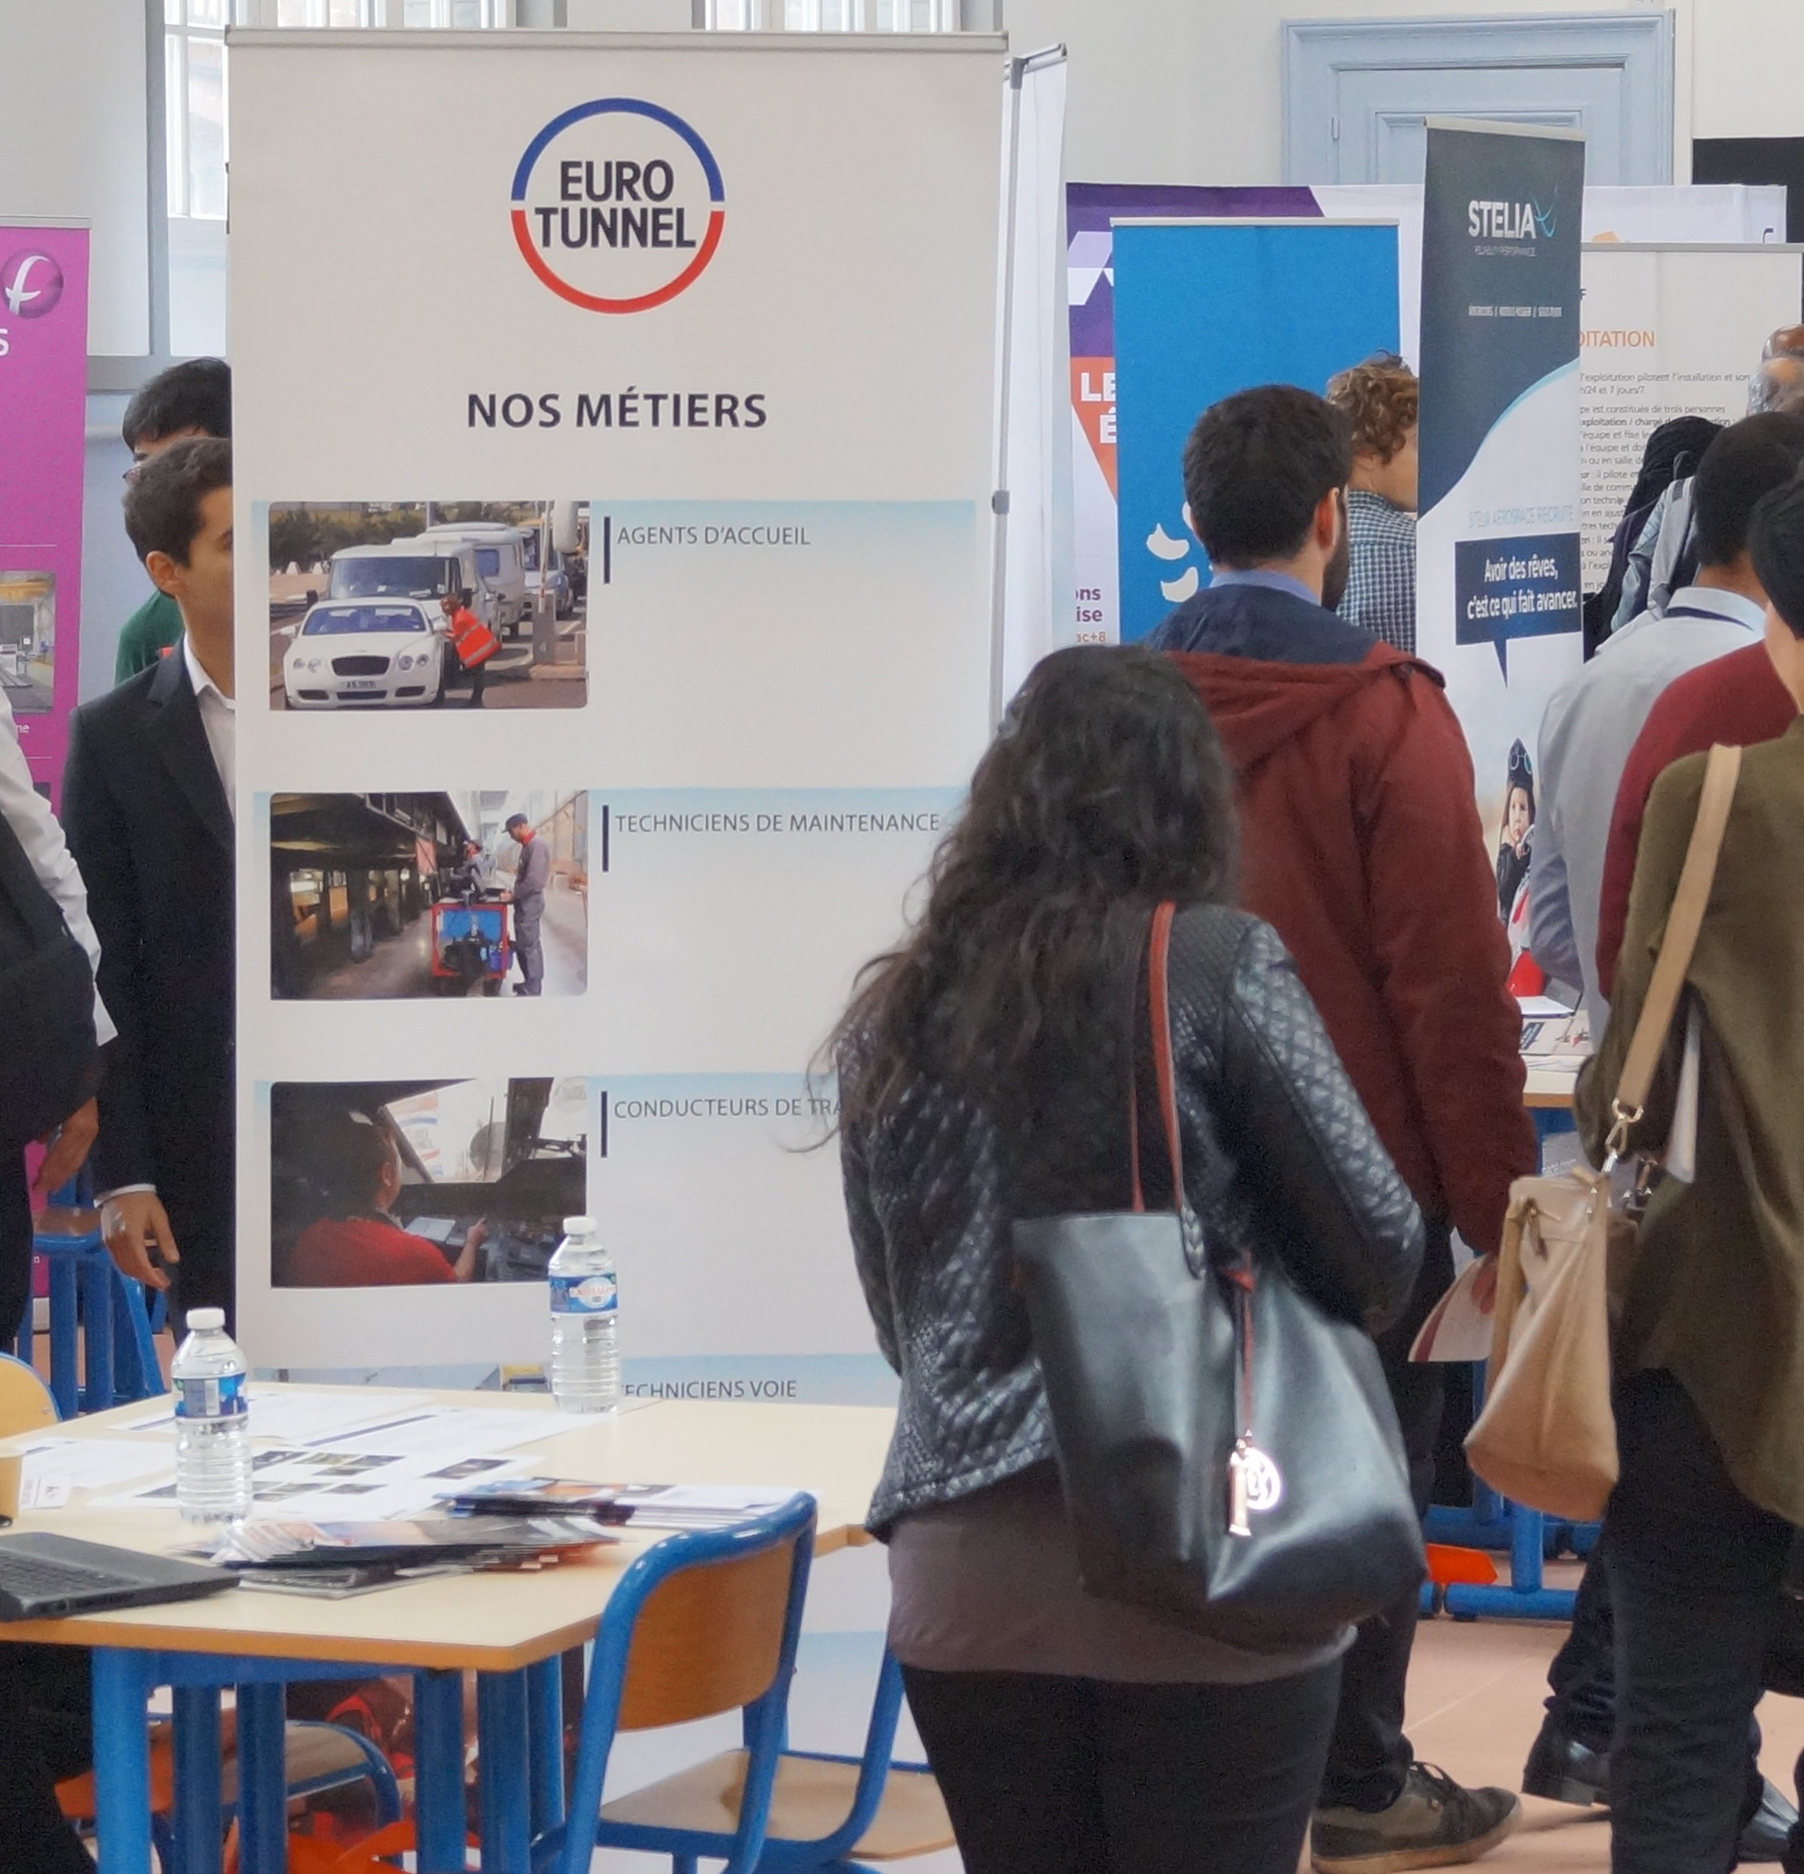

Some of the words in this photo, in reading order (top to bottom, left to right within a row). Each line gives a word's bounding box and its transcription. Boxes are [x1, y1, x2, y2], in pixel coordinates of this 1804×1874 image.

[559, 159, 674, 203] EURO
[535, 206, 697, 250] TUNNEL
[1468, 200, 1537, 239] STELIA
[468, 394, 561, 428] NOS
[576, 385, 767, 428] MÉTIERS
[617, 526, 698, 546] AGENTS
[704, 526, 811, 546] D'ACCUEIL
[1484, 557, 1507, 582] Avoir
[1508, 556, 1526, 580] des
[1528, 553, 1558, 580] rêves,
[1501, 590, 1517, 620] qui
[1518, 588, 1535, 613] fait
[614, 813, 751, 833] TECHNICIENS
[756, 813, 784, 832] DE
[789, 812, 941, 833] MAINTENANCE
[614, 1098, 769, 1119] CONDUCTEURS
[775, 1099, 802, 1116] DE
[807, 1098, 841, 1116] TRA
[623, 1380, 746, 1399] ECHNICIENS
[749, 1380, 798, 1398] VOIE
